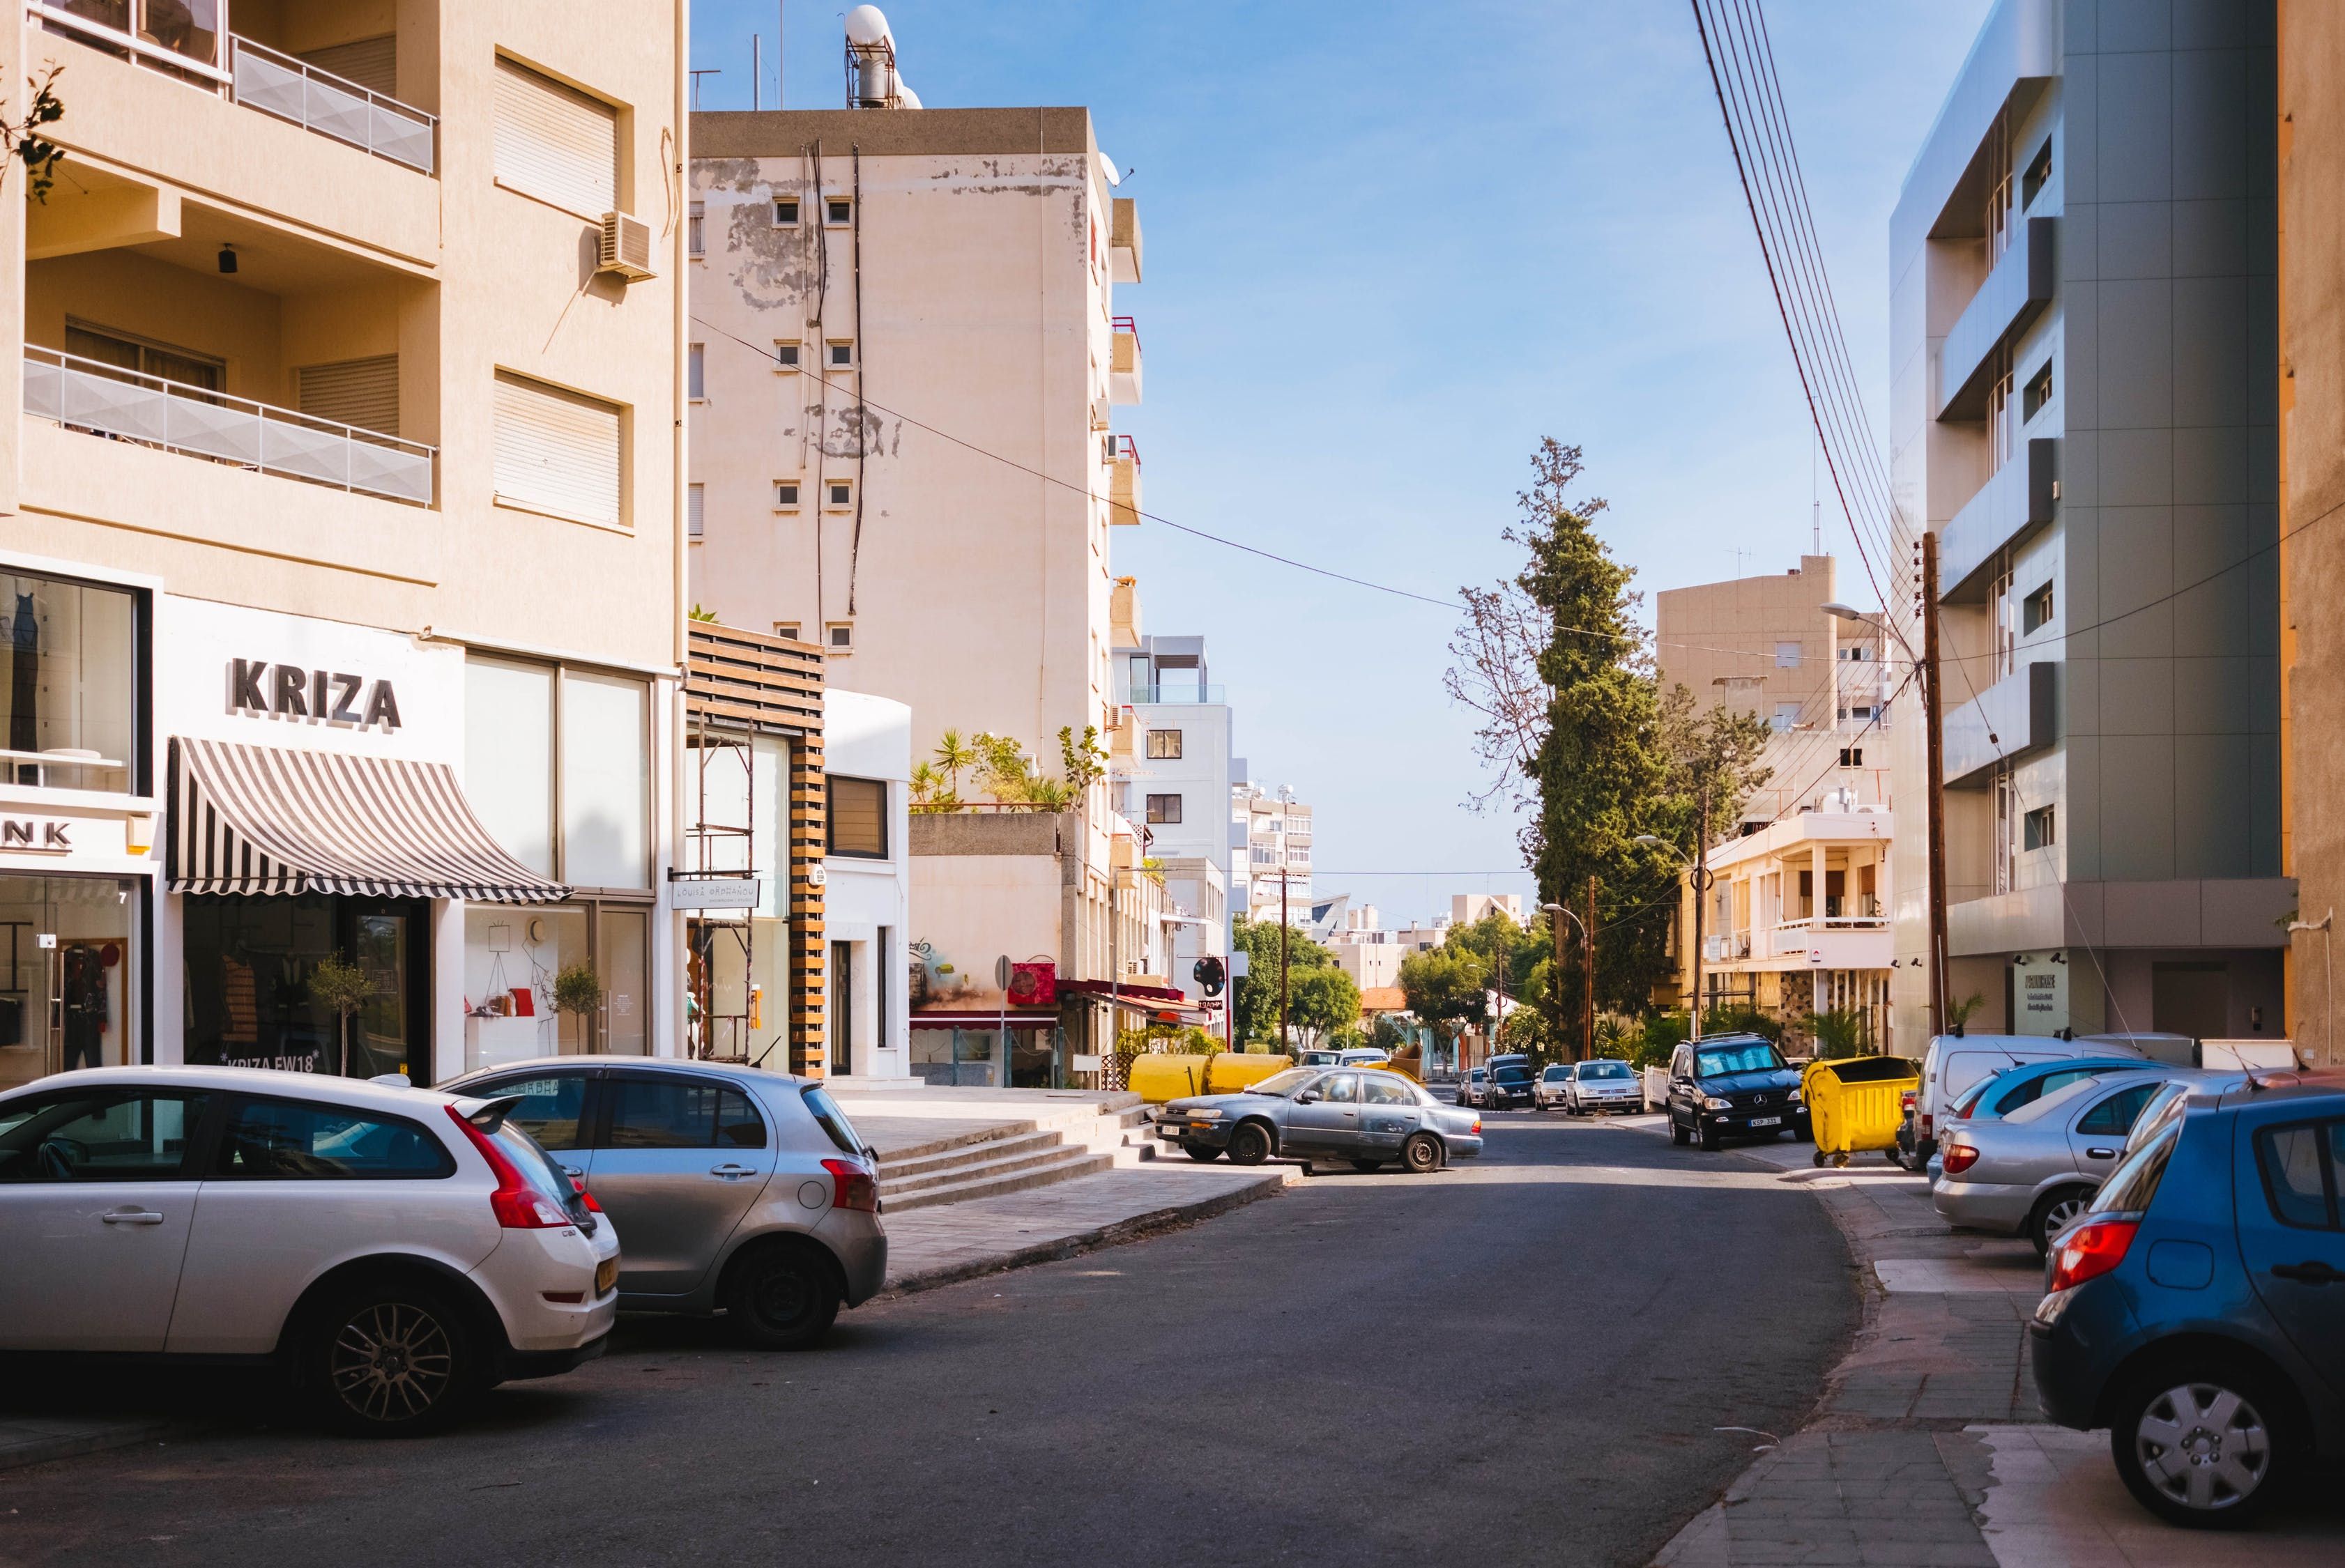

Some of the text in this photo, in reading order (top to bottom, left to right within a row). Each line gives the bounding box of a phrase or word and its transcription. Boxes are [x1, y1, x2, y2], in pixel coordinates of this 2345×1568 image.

[231, 657, 402, 728] KRIZA
[3, 820, 72, 845] NK
[119, 892, 127, 904] 7
[275, 1055, 314, 1073] FW18
